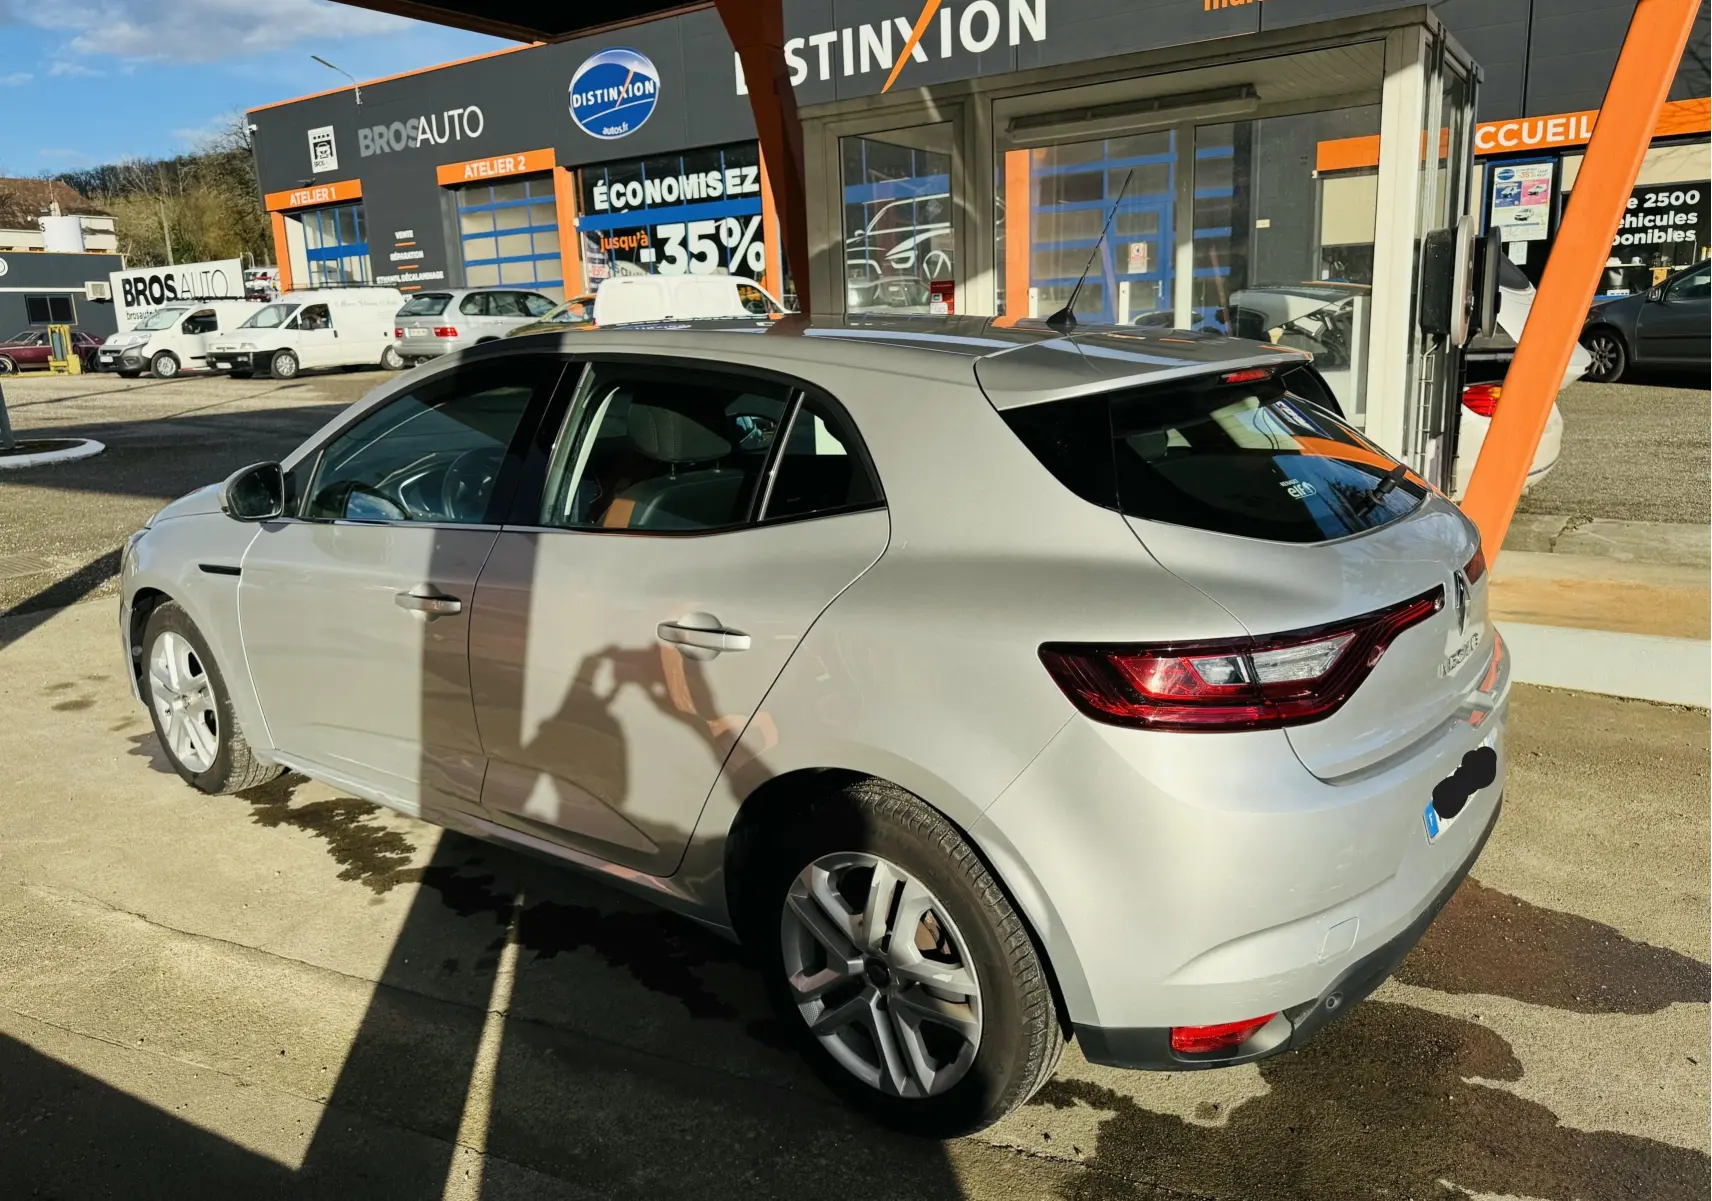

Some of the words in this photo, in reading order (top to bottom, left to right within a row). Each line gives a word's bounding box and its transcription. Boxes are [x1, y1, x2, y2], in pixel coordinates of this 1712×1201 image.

[734, 0, 1047, 95] STINXION
[572, 78, 655, 108] DISTINXION
[602, 121, 629, 135] autos.fr
[1474, 115, 1593, 149] CCUEIL
[464, 157, 515, 179] ATELIER
[517, 155, 526, 171] 2
[289, 188, 330, 206] ATELIER
[330, 186, 337, 200] 1
[592, 165, 760, 211] ÉCONOMISEZ
[1626, 197, 1639, 209] e
[1643, 189, 1701, 208] 2500
[1618, 211, 1698, 229] hicules
[600, 229, 649, 253] jusqu'à
[640, 215, 767, 276] -35%
[1611, 228, 1697, 246] onibles
